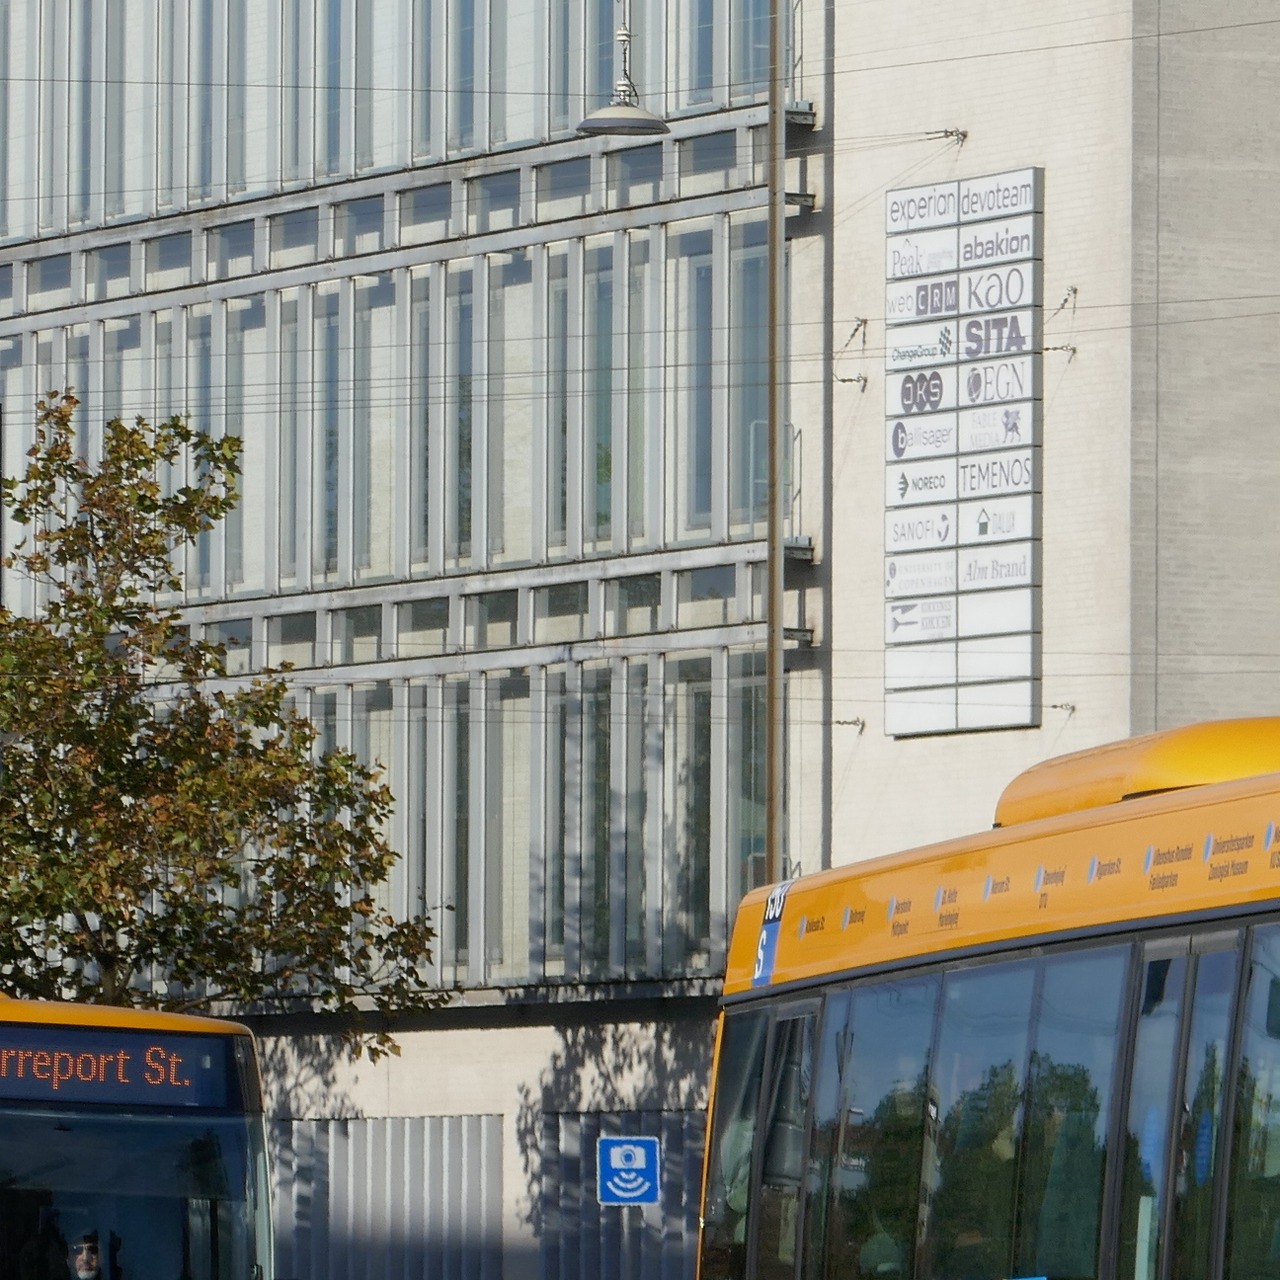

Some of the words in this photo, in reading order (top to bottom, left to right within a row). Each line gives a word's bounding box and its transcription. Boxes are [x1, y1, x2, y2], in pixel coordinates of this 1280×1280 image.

[890, 187, 956, 228] experian
[961, 182, 1032, 216] devoteam
[892, 245, 923, 276] Peak
[963, 228, 1030, 262] abakion
[965, 315, 1027, 359] SITA
[912, 474, 946, 492] NORECO
[960, 457, 1031, 492] TEMENOS
[893, 520, 934, 542] SANOFI
[963, 560, 988, 583] Alm
[991, 555, 1026, 580] Brand
[754, 929, 768, 980] S
[144, 1046, 191, 1087] St.
